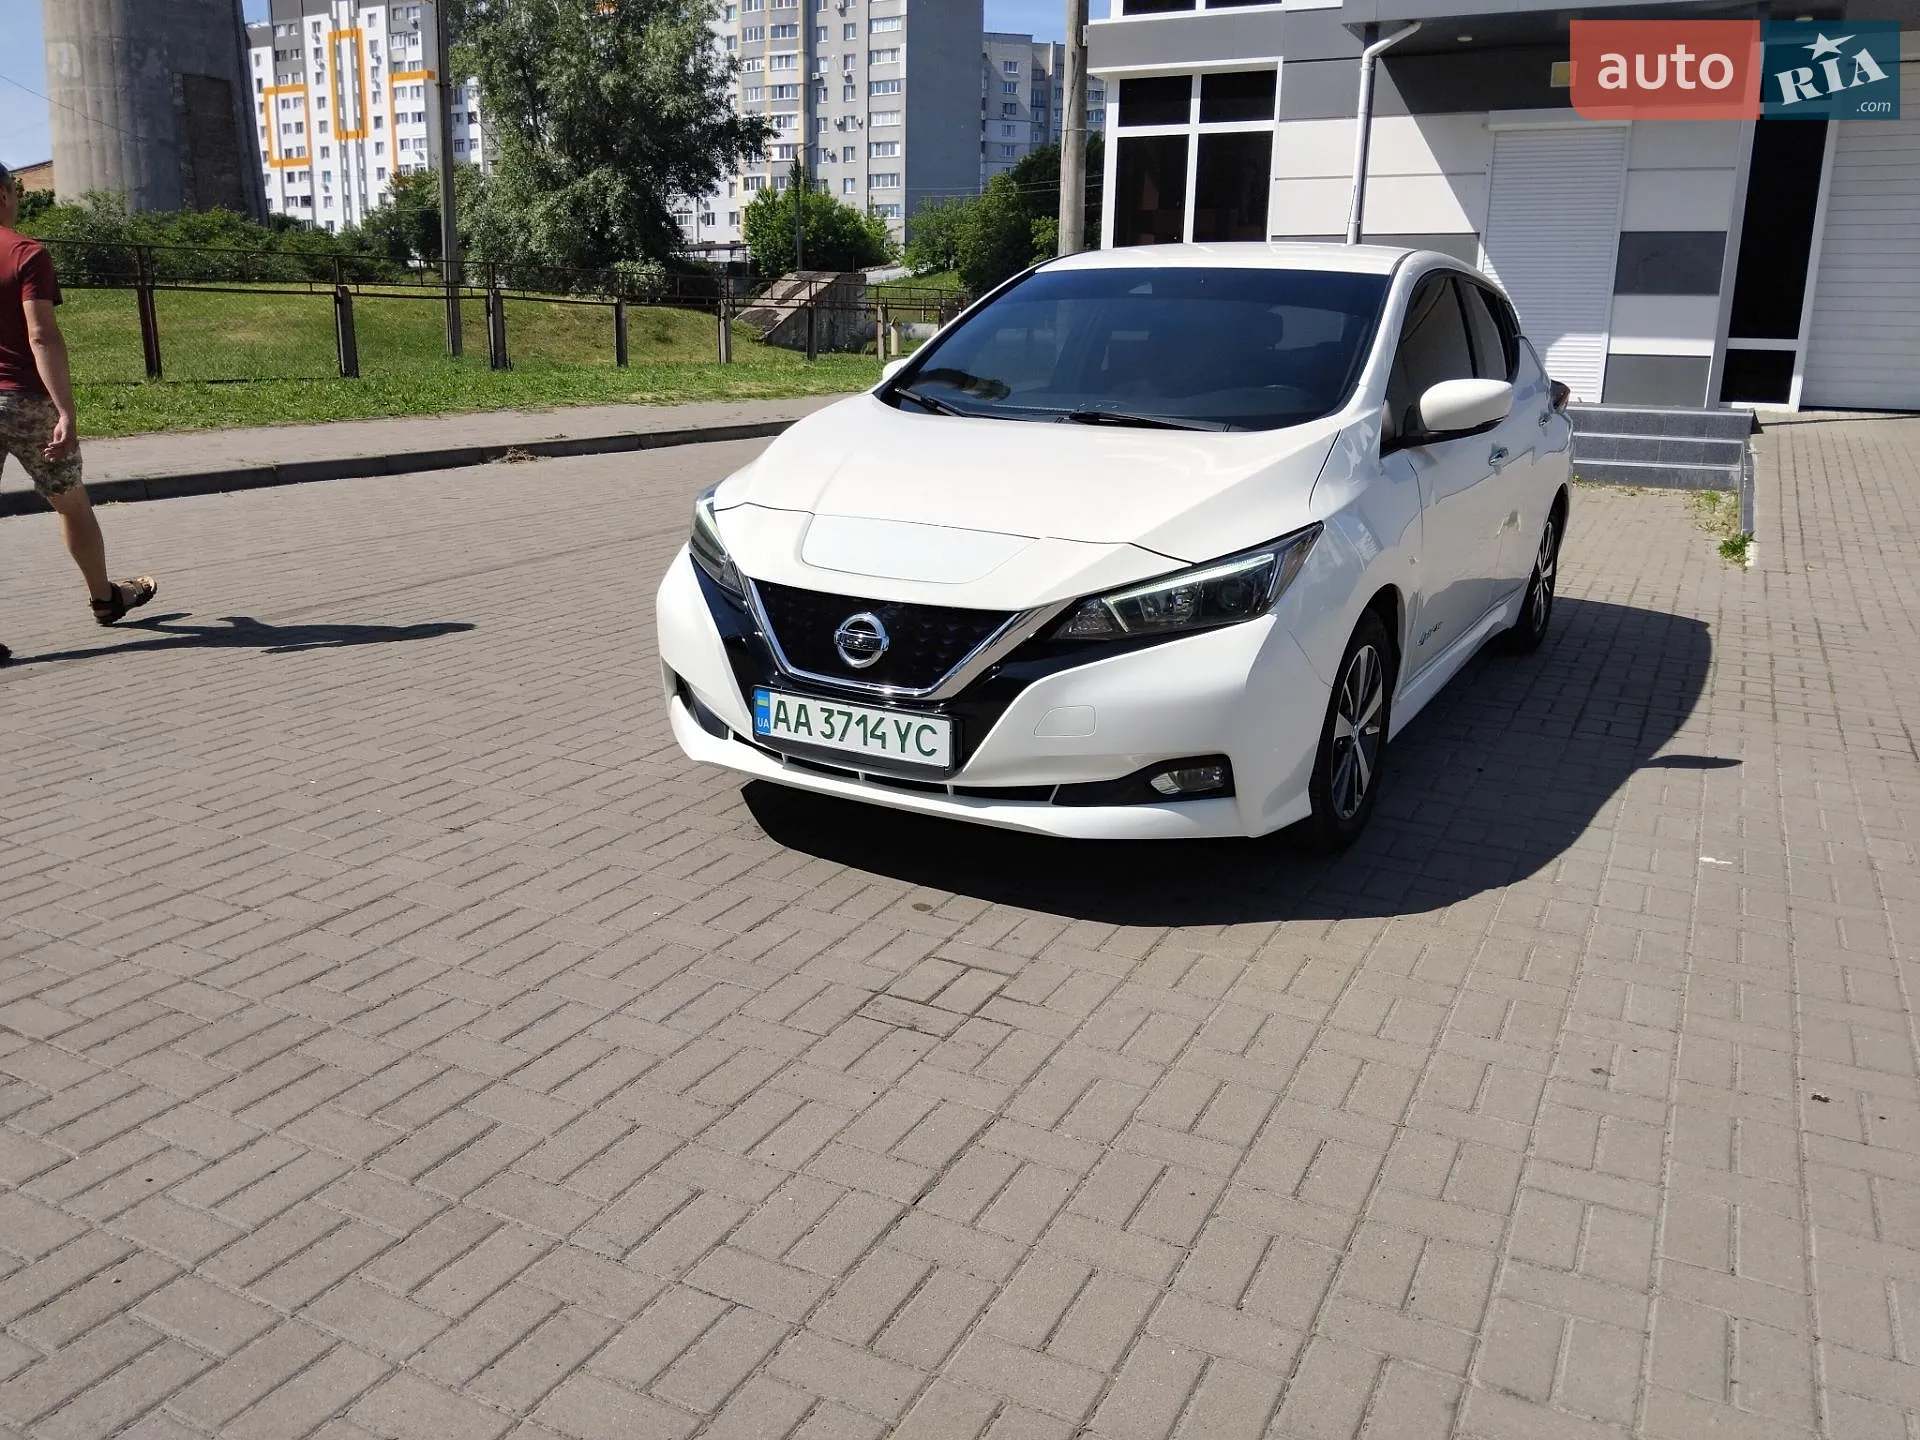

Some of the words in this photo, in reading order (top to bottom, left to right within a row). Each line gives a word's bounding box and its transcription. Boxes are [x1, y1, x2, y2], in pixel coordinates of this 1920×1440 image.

[757, 717, 769, 729] UA
[773, 699, 813, 737] AA
[820, 707, 887, 749] 3714
[894, 719, 938, 757] YC
